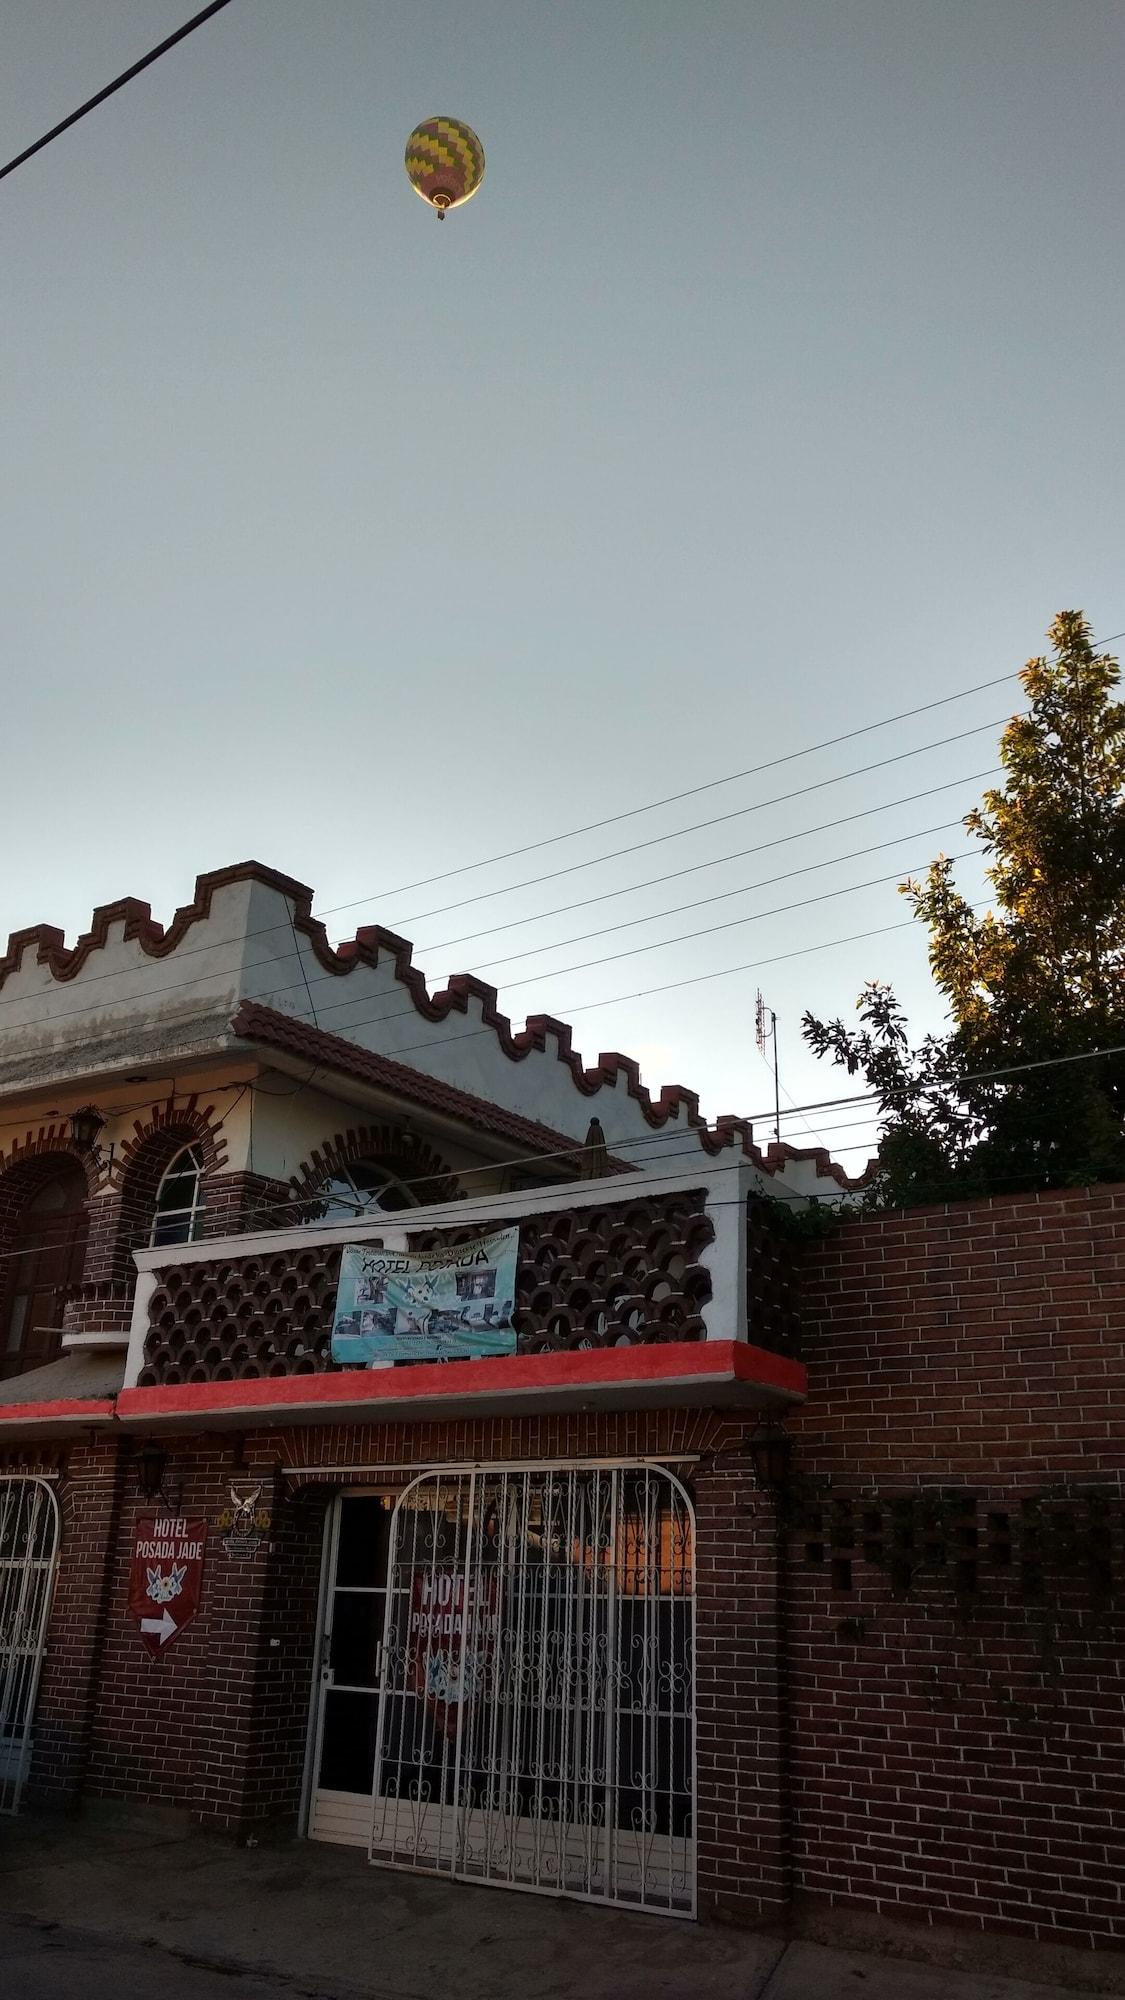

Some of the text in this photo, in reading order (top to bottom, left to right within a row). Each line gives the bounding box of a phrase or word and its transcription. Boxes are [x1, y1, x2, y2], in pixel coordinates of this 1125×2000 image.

[361, 1257, 410, 1274] HOTEL
[153, 1518, 189, 1538] HOTEL
[136, 1541, 203, 1560] POSADA JADE
[422, 1574, 490, 1607] HOTEL
